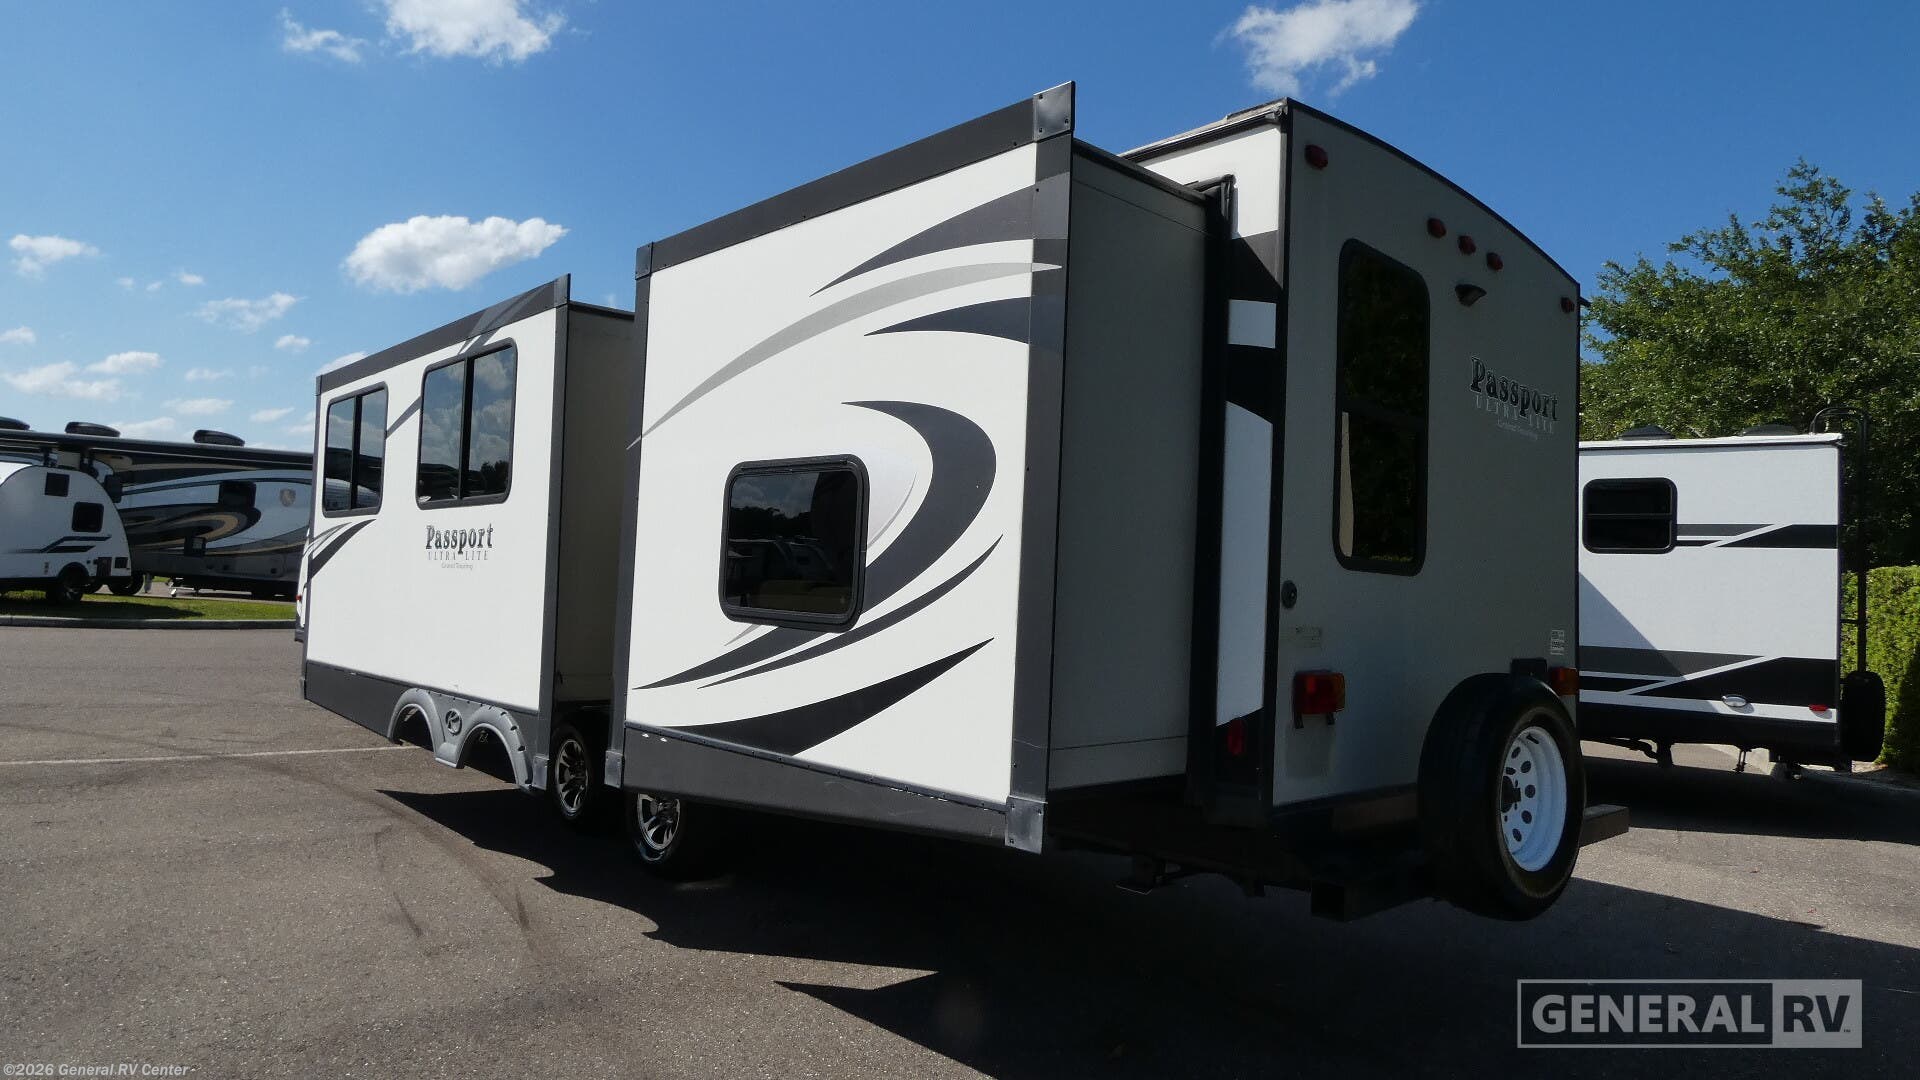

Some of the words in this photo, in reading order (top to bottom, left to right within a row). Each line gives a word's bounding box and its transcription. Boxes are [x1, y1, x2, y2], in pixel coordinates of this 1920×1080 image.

[1470, 356, 1558, 421] Passport
[425, 522, 494, 555] Passport
[465, 549, 489, 561] LITE
